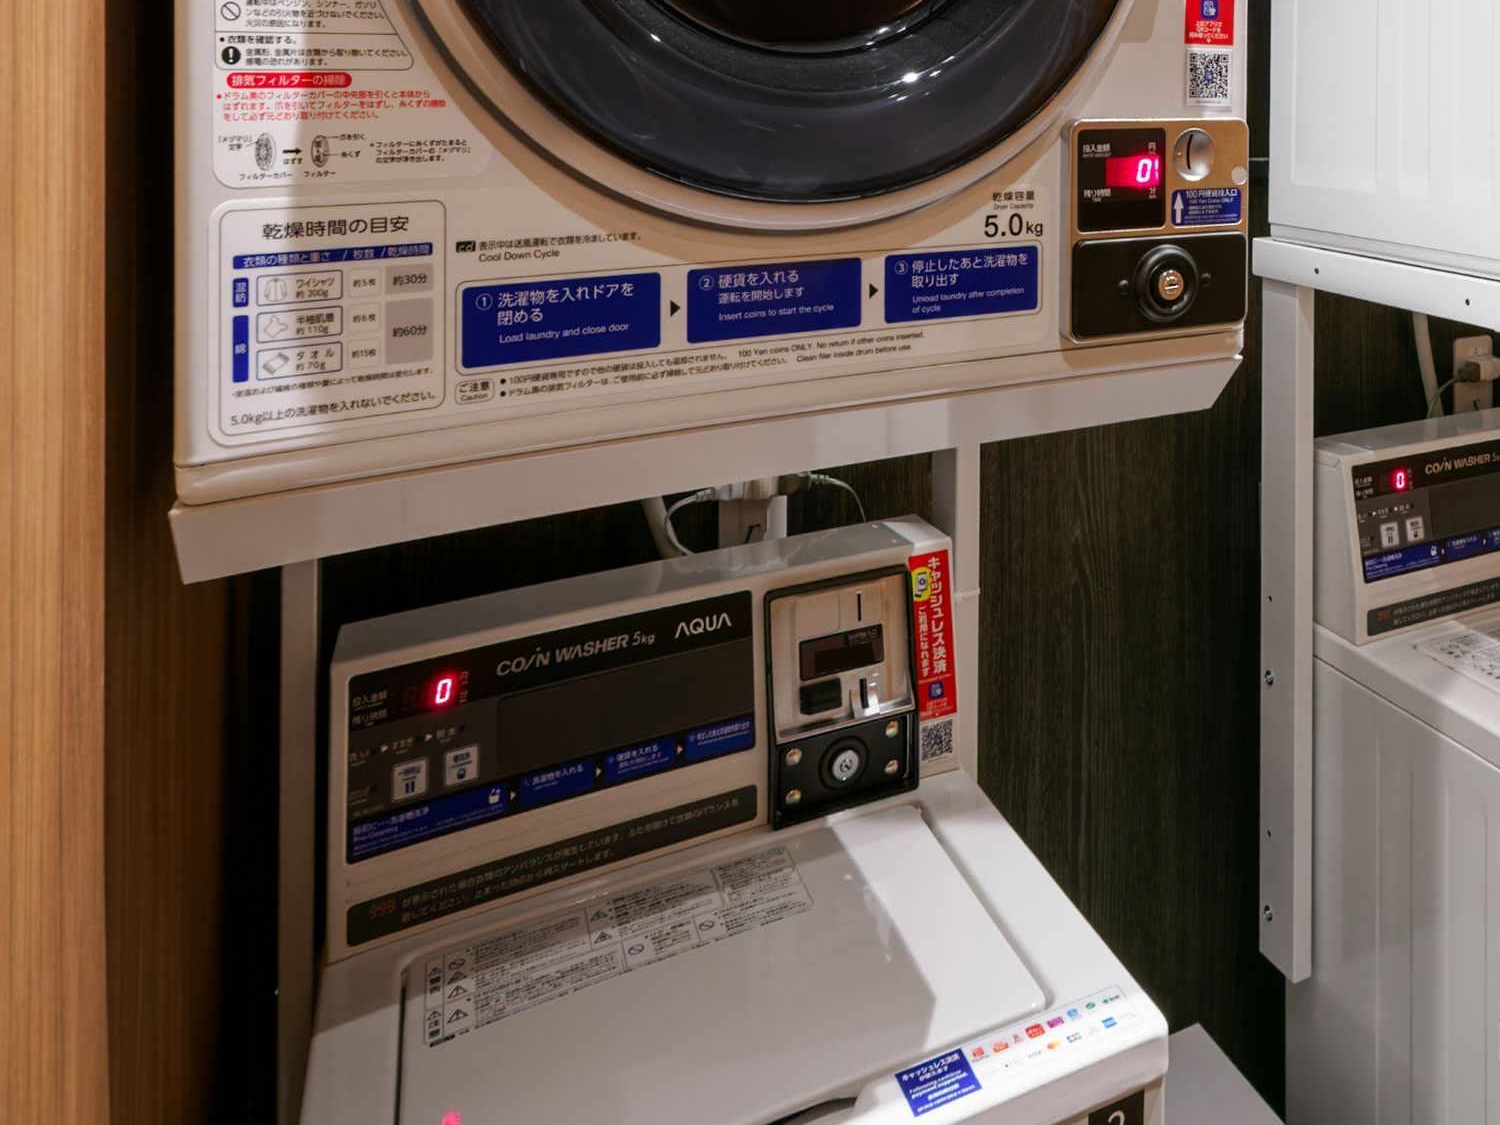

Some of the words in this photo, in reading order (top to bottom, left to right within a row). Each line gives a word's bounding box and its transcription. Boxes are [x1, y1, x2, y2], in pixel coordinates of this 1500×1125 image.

[227, 35, 297, 45] 衣類を確認する。
[231, 74, 346, 88] 排気フィルターの掃除
[303, 170, 336, 178] フィルター
[992, 191, 1035, 203] 乾燥容量
[263, 216, 409, 240] 乾燥時間の目安
[479, 252, 501, 263] Cool
[504, 250, 531, 261] Down
[533, 249, 560, 260] Cycle
[912, 253, 1029, 273] 停止したあと洗濯物を
[718, 271, 799, 289] 硬貨を入れる
[912, 273, 958, 288] 取り出す
[498, 282, 634, 308] 洗濯物を入れドアを
[718, 286, 805, 305] 運転を開始します
[912, 293, 938, 304] Unload
[940, 292, 966, 302] laundry
[968, 289, 985, 299] after
[987, 286, 1024, 298] completion
[498, 308, 544, 326] 閉める
[719, 310, 741, 321] Insert
[744, 308, 766, 319] coins
[768, 308, 777, 317] to
[778, 306, 797, 316] start
[799, 304, 811, 314] the
[813, 302, 834, 315] cycle
[913, 305, 920, 314] of
[922, 303, 941, 315] cycle
[499, 331, 523, 344] Load
[526, 328, 561, 342] laundry
[562, 327, 580, 338] and
[582, 325, 607, 336] close
[609, 322, 629, 332] door
[458, 380, 491, 395] ご注意
[738, 349, 751, 359] 100
[817, 341, 827, 350] No
[231, 392, 436, 426] 5.0kg以上の洗濯物を入れないでください。
[1453, 453, 1491, 469] WASHER
[1396, 471, 1405, 490] 0
[928, 556, 948, 674] キャッシュレス決済
[675, 613, 732, 638] AQUA
[496, 647, 550, 676] COIN
[556, 634, 629, 663] WASHER
[632, 632, 656, 647] 5kg
[435, 678, 452, 704] 0
